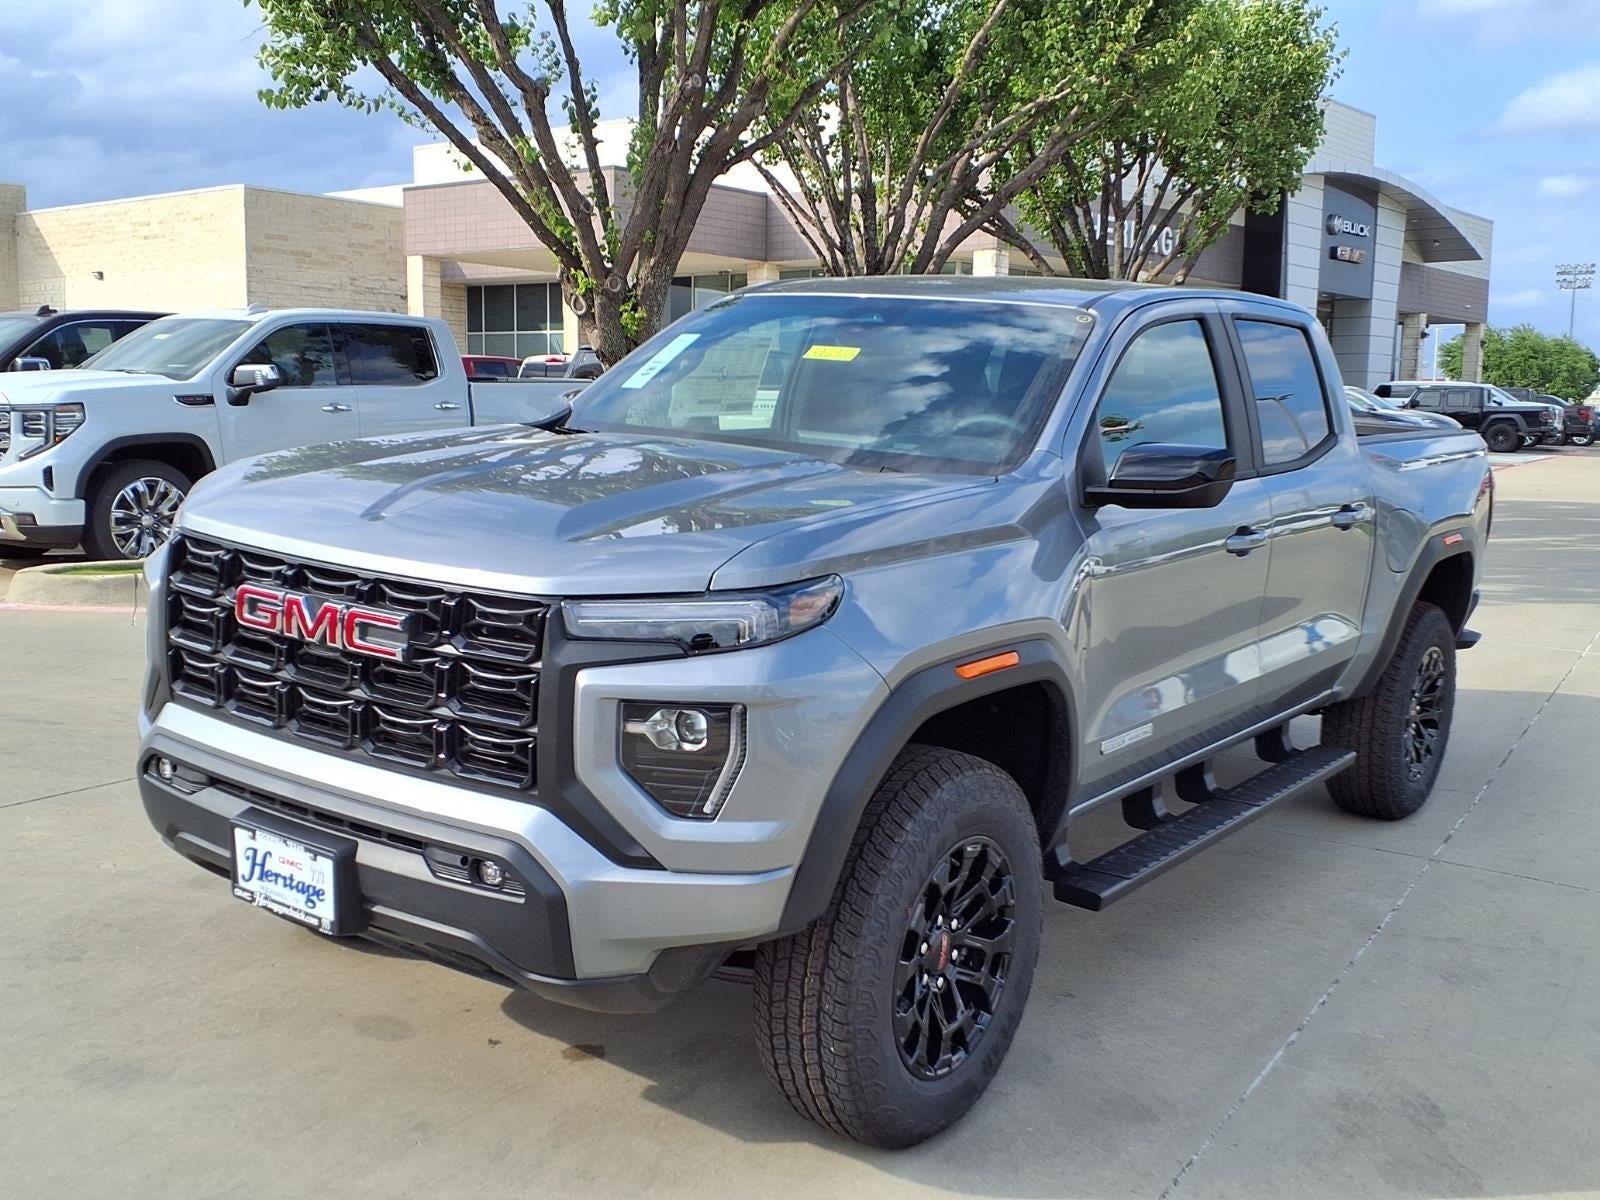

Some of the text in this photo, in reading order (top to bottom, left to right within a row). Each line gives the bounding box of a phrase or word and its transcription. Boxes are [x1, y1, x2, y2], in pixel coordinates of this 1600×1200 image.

[1091, 211, 1182, 257] HERIAG
[1343, 220, 1370, 237] BUICK
[234, 584, 408, 662] GMC
[241, 846, 325, 909] Heritage
[278, 856, 304, 871] GMC
